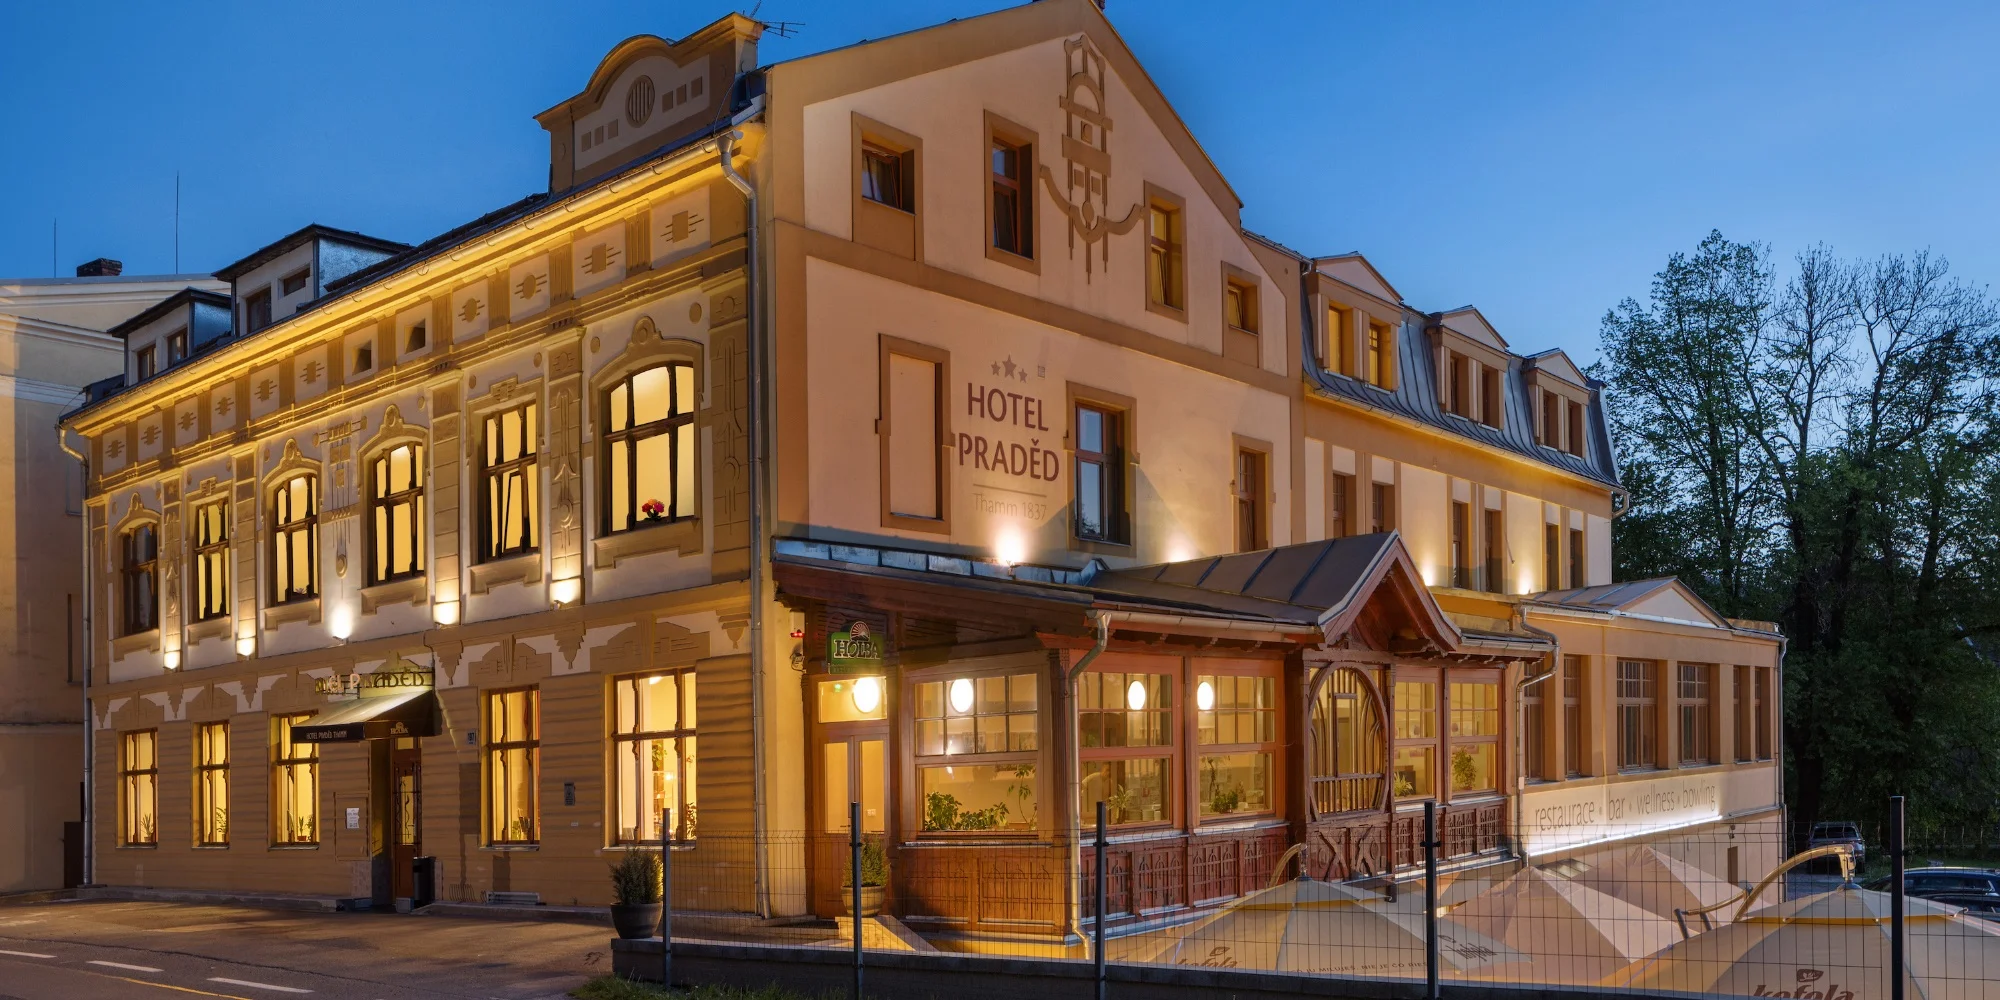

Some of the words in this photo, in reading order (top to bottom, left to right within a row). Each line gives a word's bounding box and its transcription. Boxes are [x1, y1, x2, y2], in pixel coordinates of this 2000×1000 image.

[967, 382, 1049, 432] HOTEL
[958, 432, 1060, 482] PRADĚD
[972, 492, 1018, 517] Thamm
[1022, 501, 1047, 520] 1837
[834, 639, 880, 660] HOLBA
[1535, 801, 1595, 832] restaurace
[1608, 788, 1625, 821] bar
[1636, 783, 1675, 815] wellness
[1682, 779, 1716, 812] bowling
